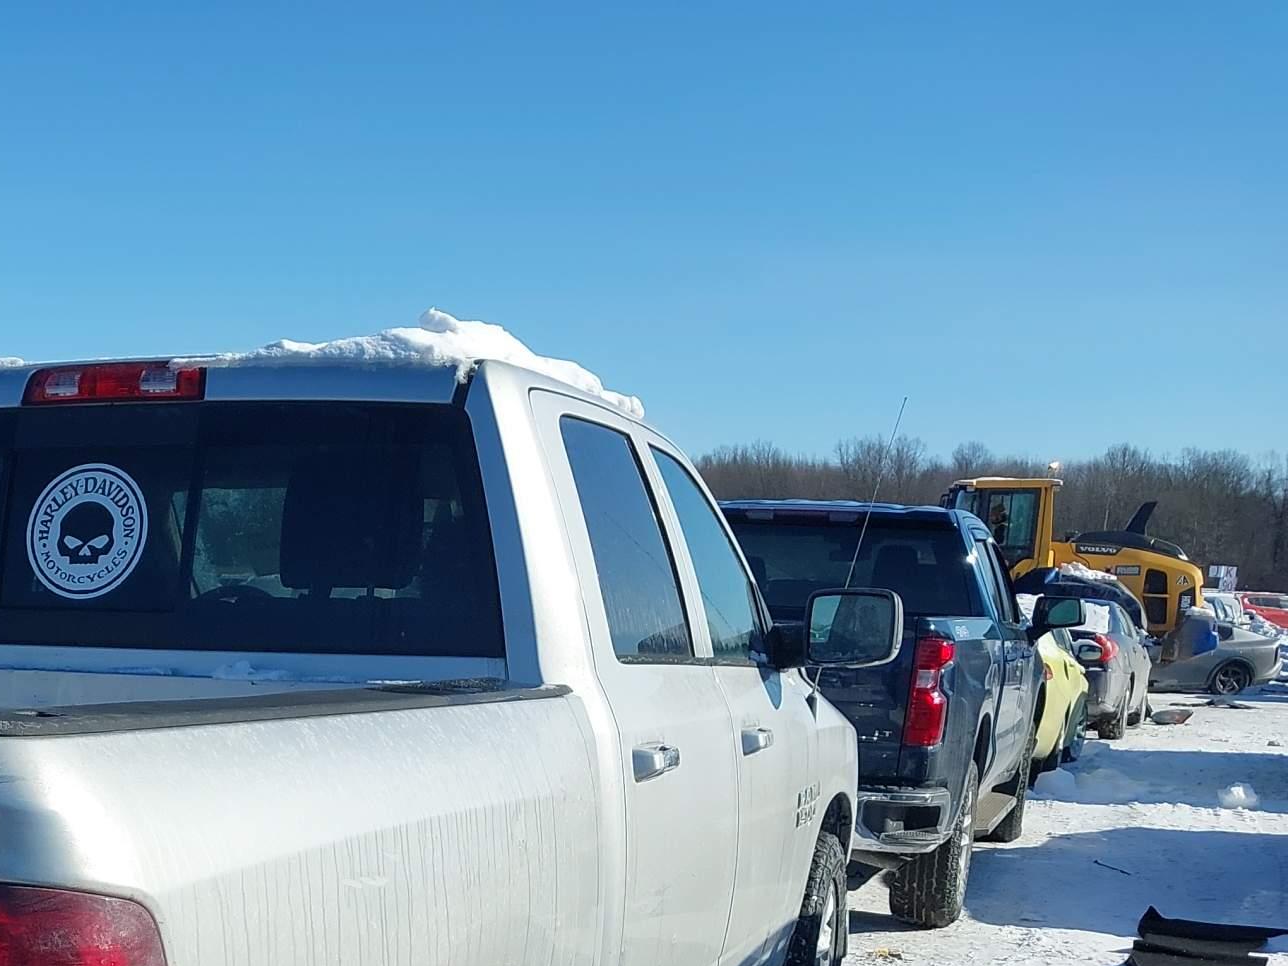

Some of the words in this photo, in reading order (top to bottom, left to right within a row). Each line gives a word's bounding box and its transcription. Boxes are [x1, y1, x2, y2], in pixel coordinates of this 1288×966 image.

[38, 476, 136, 541] HARLEY-DAVIDSON
[40, 548, 128, 584] MOTORCYCLES
[1079, 546, 1117, 554] VOLVO
